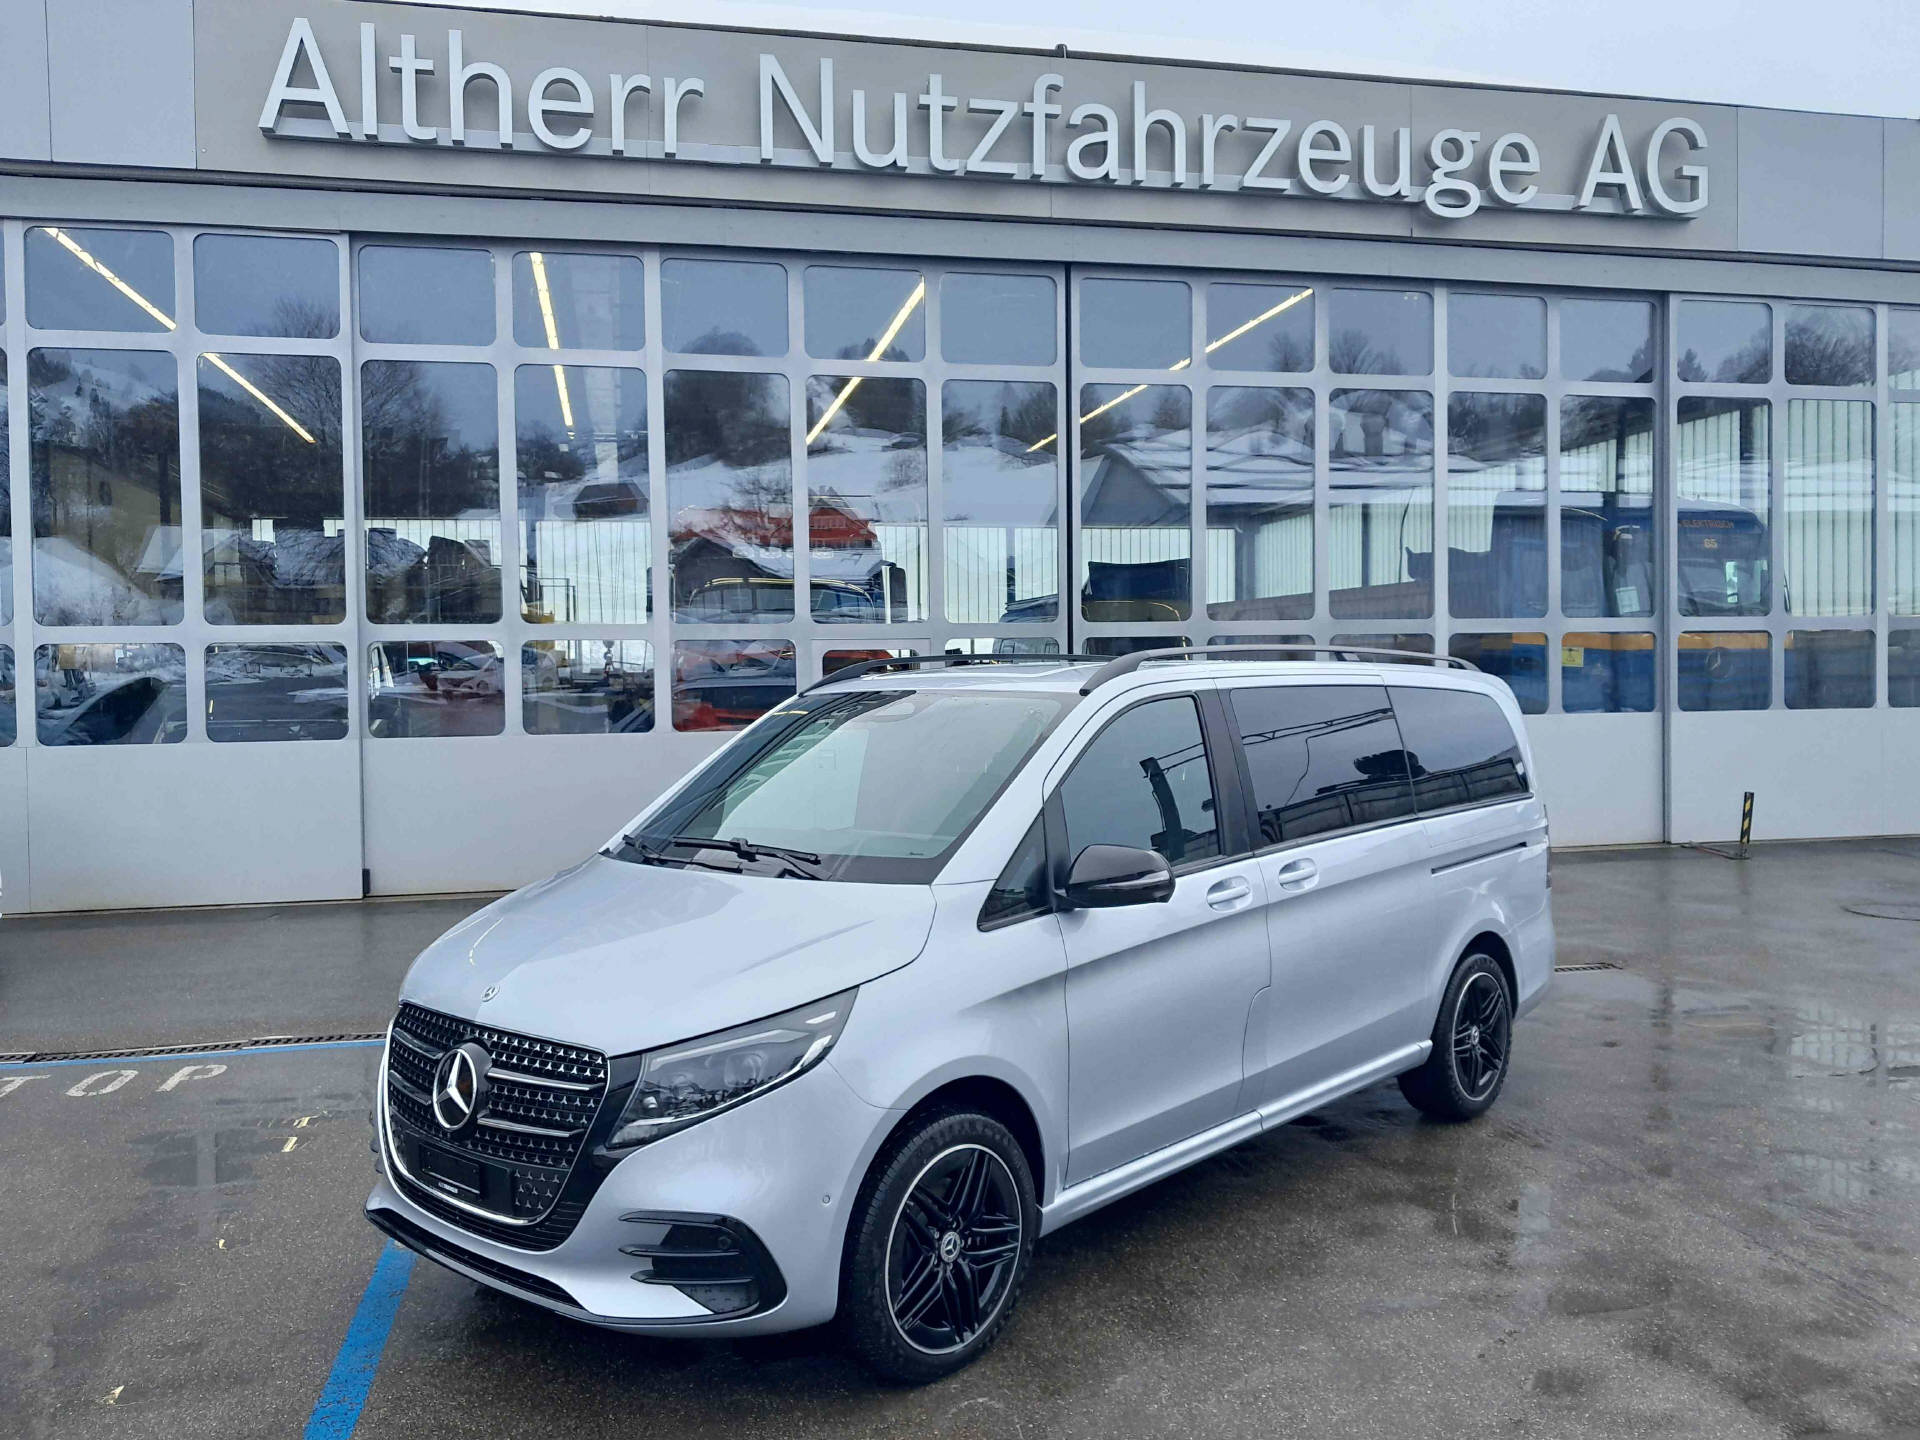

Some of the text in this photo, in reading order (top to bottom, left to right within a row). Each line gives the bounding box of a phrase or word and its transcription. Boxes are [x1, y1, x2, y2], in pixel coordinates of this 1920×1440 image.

[258, 17, 1709, 218] Altherr Nutzfahrzeuge AG
